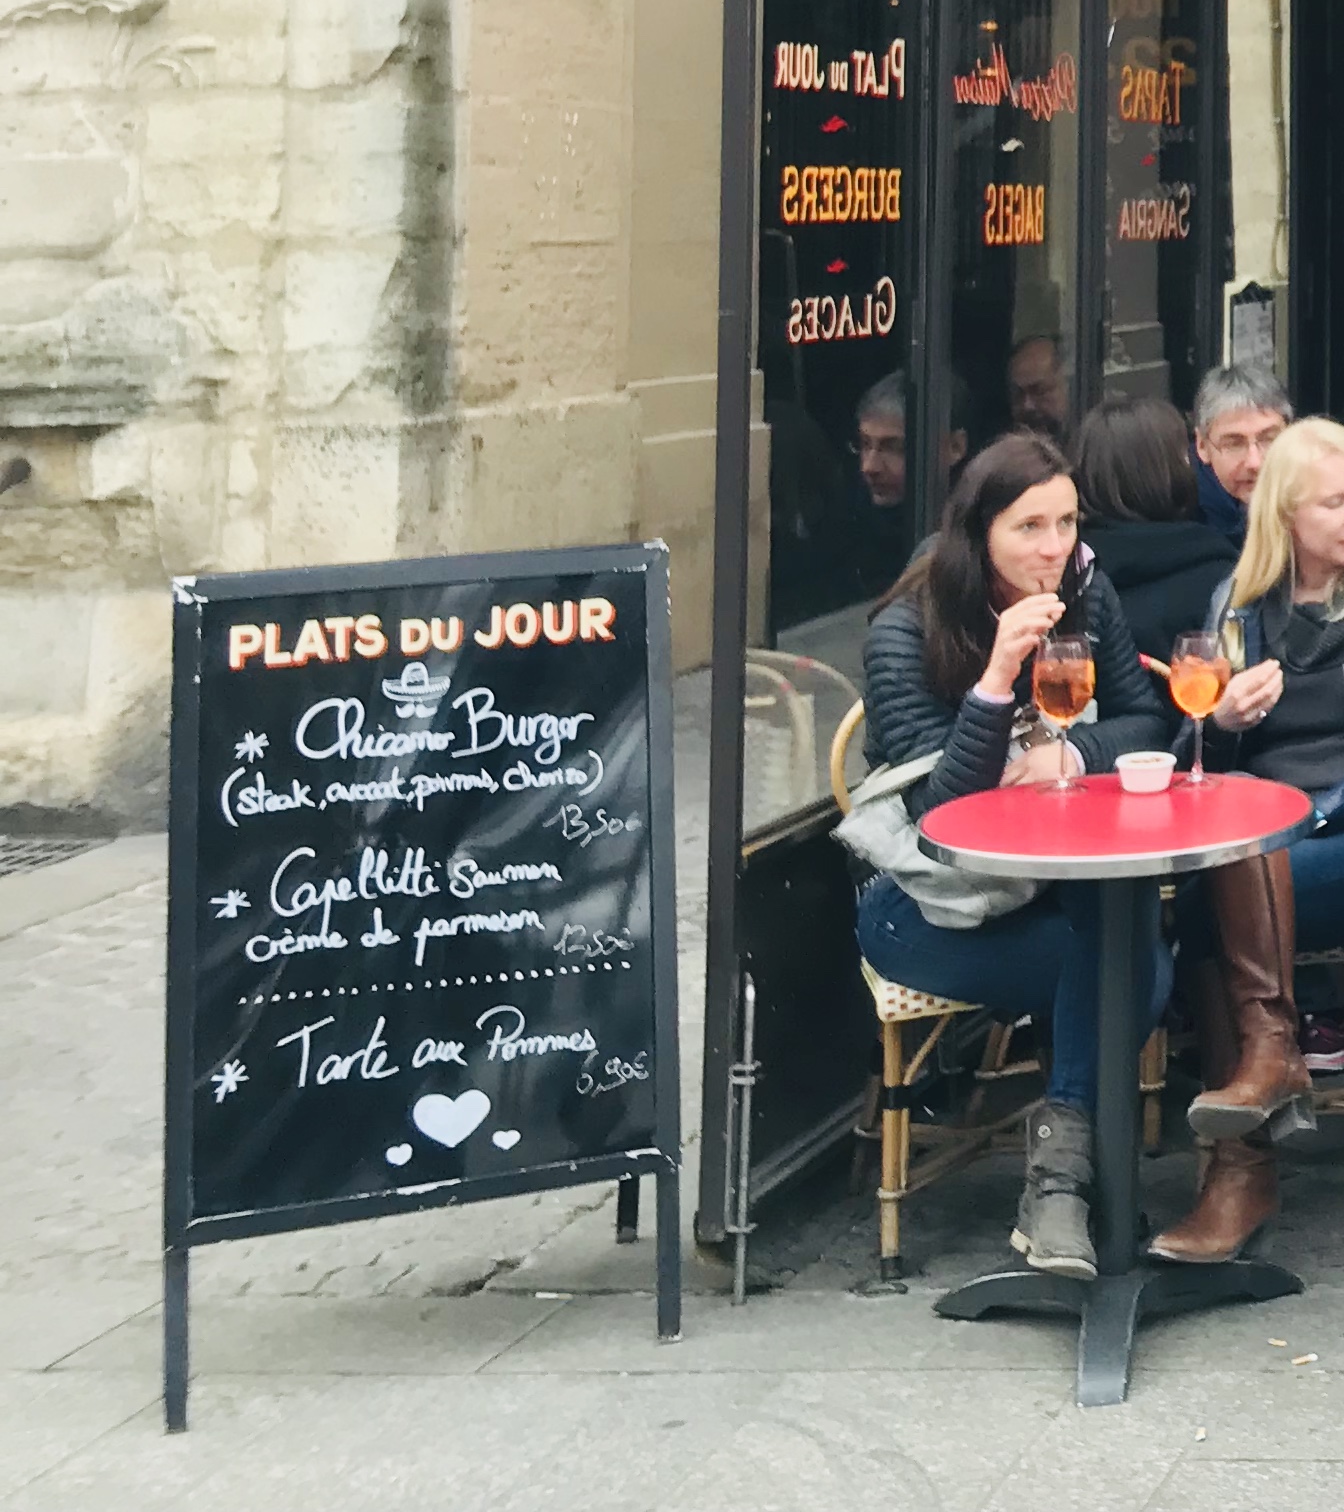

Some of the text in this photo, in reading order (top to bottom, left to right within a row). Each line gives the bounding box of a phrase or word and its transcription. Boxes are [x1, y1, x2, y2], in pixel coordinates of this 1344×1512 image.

[228, 596, 618, 671] PLATS DU JOUR
[450, 686, 596, 765] Burger
[244, 927, 348, 964] crème
[359, 906, 402, 949] de
[275, 1003, 598, 1089] Tarte aux Pommes
